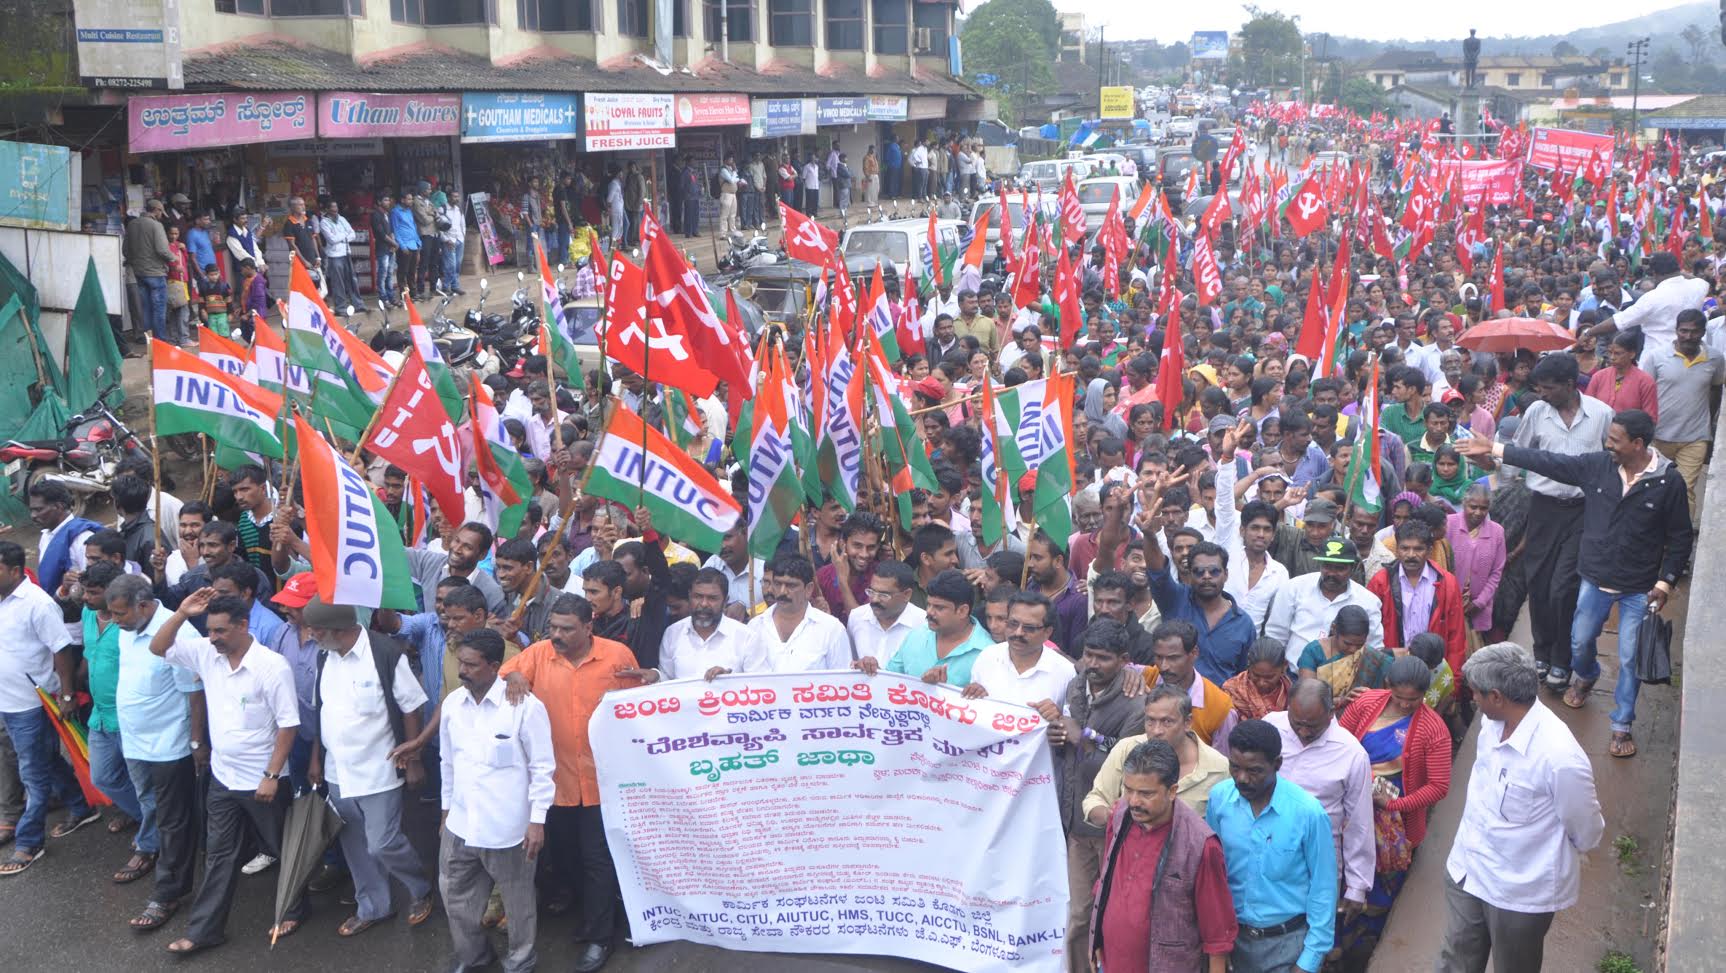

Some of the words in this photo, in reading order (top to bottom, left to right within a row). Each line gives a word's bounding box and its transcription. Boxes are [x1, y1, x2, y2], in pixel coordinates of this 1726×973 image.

[80, 31, 99, 40] Multi
[100, 31, 124, 40] Cuisine
[330, 98, 400, 125] Utham
[402, 100, 459, 125] Stores
[478, 108, 522, 127] GOUTHAM
[524, 107, 564, 125] MEDICALS
[611, 107, 636, 119] LOYAL
[638, 106, 663, 119] FRUITS
[592, 137, 632, 149] FRESH
[636, 136, 670, 147] JUICE
[614, 447, 720, 521] INTUC
[613, 697, 681, 720] ಜಂಟಿ
[698, 685, 777, 717] ಕ್ರಿಯಾ
[792, 682, 872, 704] ಸಮಿತಿ
[887, 683, 978, 725] ಕೊಡಗು
[727, 708, 792, 724] ಕಾರ್ಮಿಕ
[800, 705, 851, 719] ವರ್ಗದ
[690, 749, 780, 782] ಬೃಹತ್
[797, 750, 875, 766] ಜಾಥಾ
[722, 899, 769, 910] ಕಾರ್ಮಿಕ
[776, 893, 848, 908] ಸಂಘಟನೆಗಳ
[855, 894, 885, 905] ಜಂಟಿ
[892, 896, 926, 909] ಸಮಿತಿ
[932, 898, 966, 919] ಕೊಡಗು
[688, 912, 733, 925] AITUC,
[736, 914, 773, 926] CITU,
[776, 910, 834, 923] AIUTUC,
[838, 909, 873, 921] HMS,
[876, 910, 918, 925] TUCC,
[921, 914, 971, 936] AICCTU,
[973, 925, 1006, 945] BSNL,
[718, 926, 747, 941] ರಾಜ್ಯ
[752, 926, 783, 937] ಸೇವಾ
[790, 923, 831, 937] ನೌಕರರ
